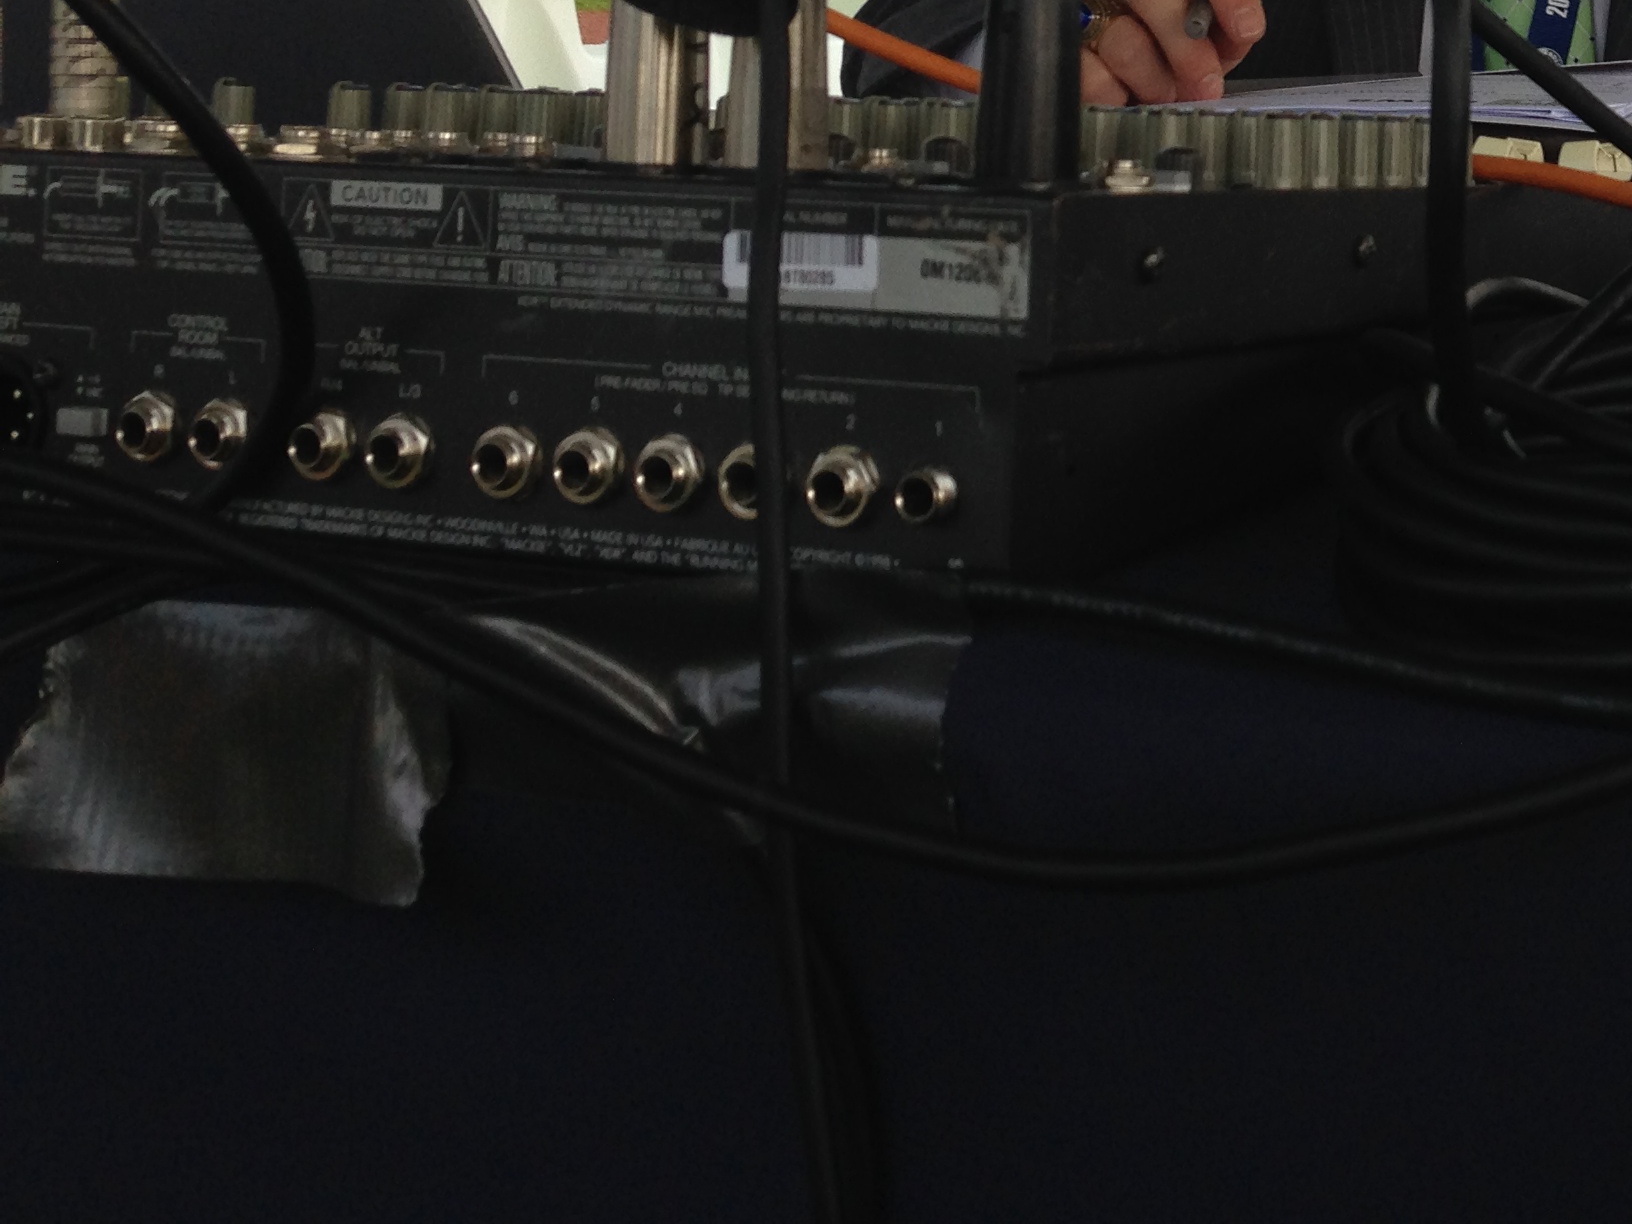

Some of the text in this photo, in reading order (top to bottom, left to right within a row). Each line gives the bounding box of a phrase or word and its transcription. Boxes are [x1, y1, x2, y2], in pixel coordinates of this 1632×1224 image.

[341, 185, 429, 205] CAUTION
[167, 314, 229, 331] CONTROL
[178, 329, 219, 345] ROOM
[358, 327, 383, 341] ALT
[344, 341, 399, 358] OUTPUT
[662, 361, 729, 381] CHANNEL
[673, 402, 683, 418] 4
[845, 413, 857, 430] 2
[935, 420, 943, 437] 1
